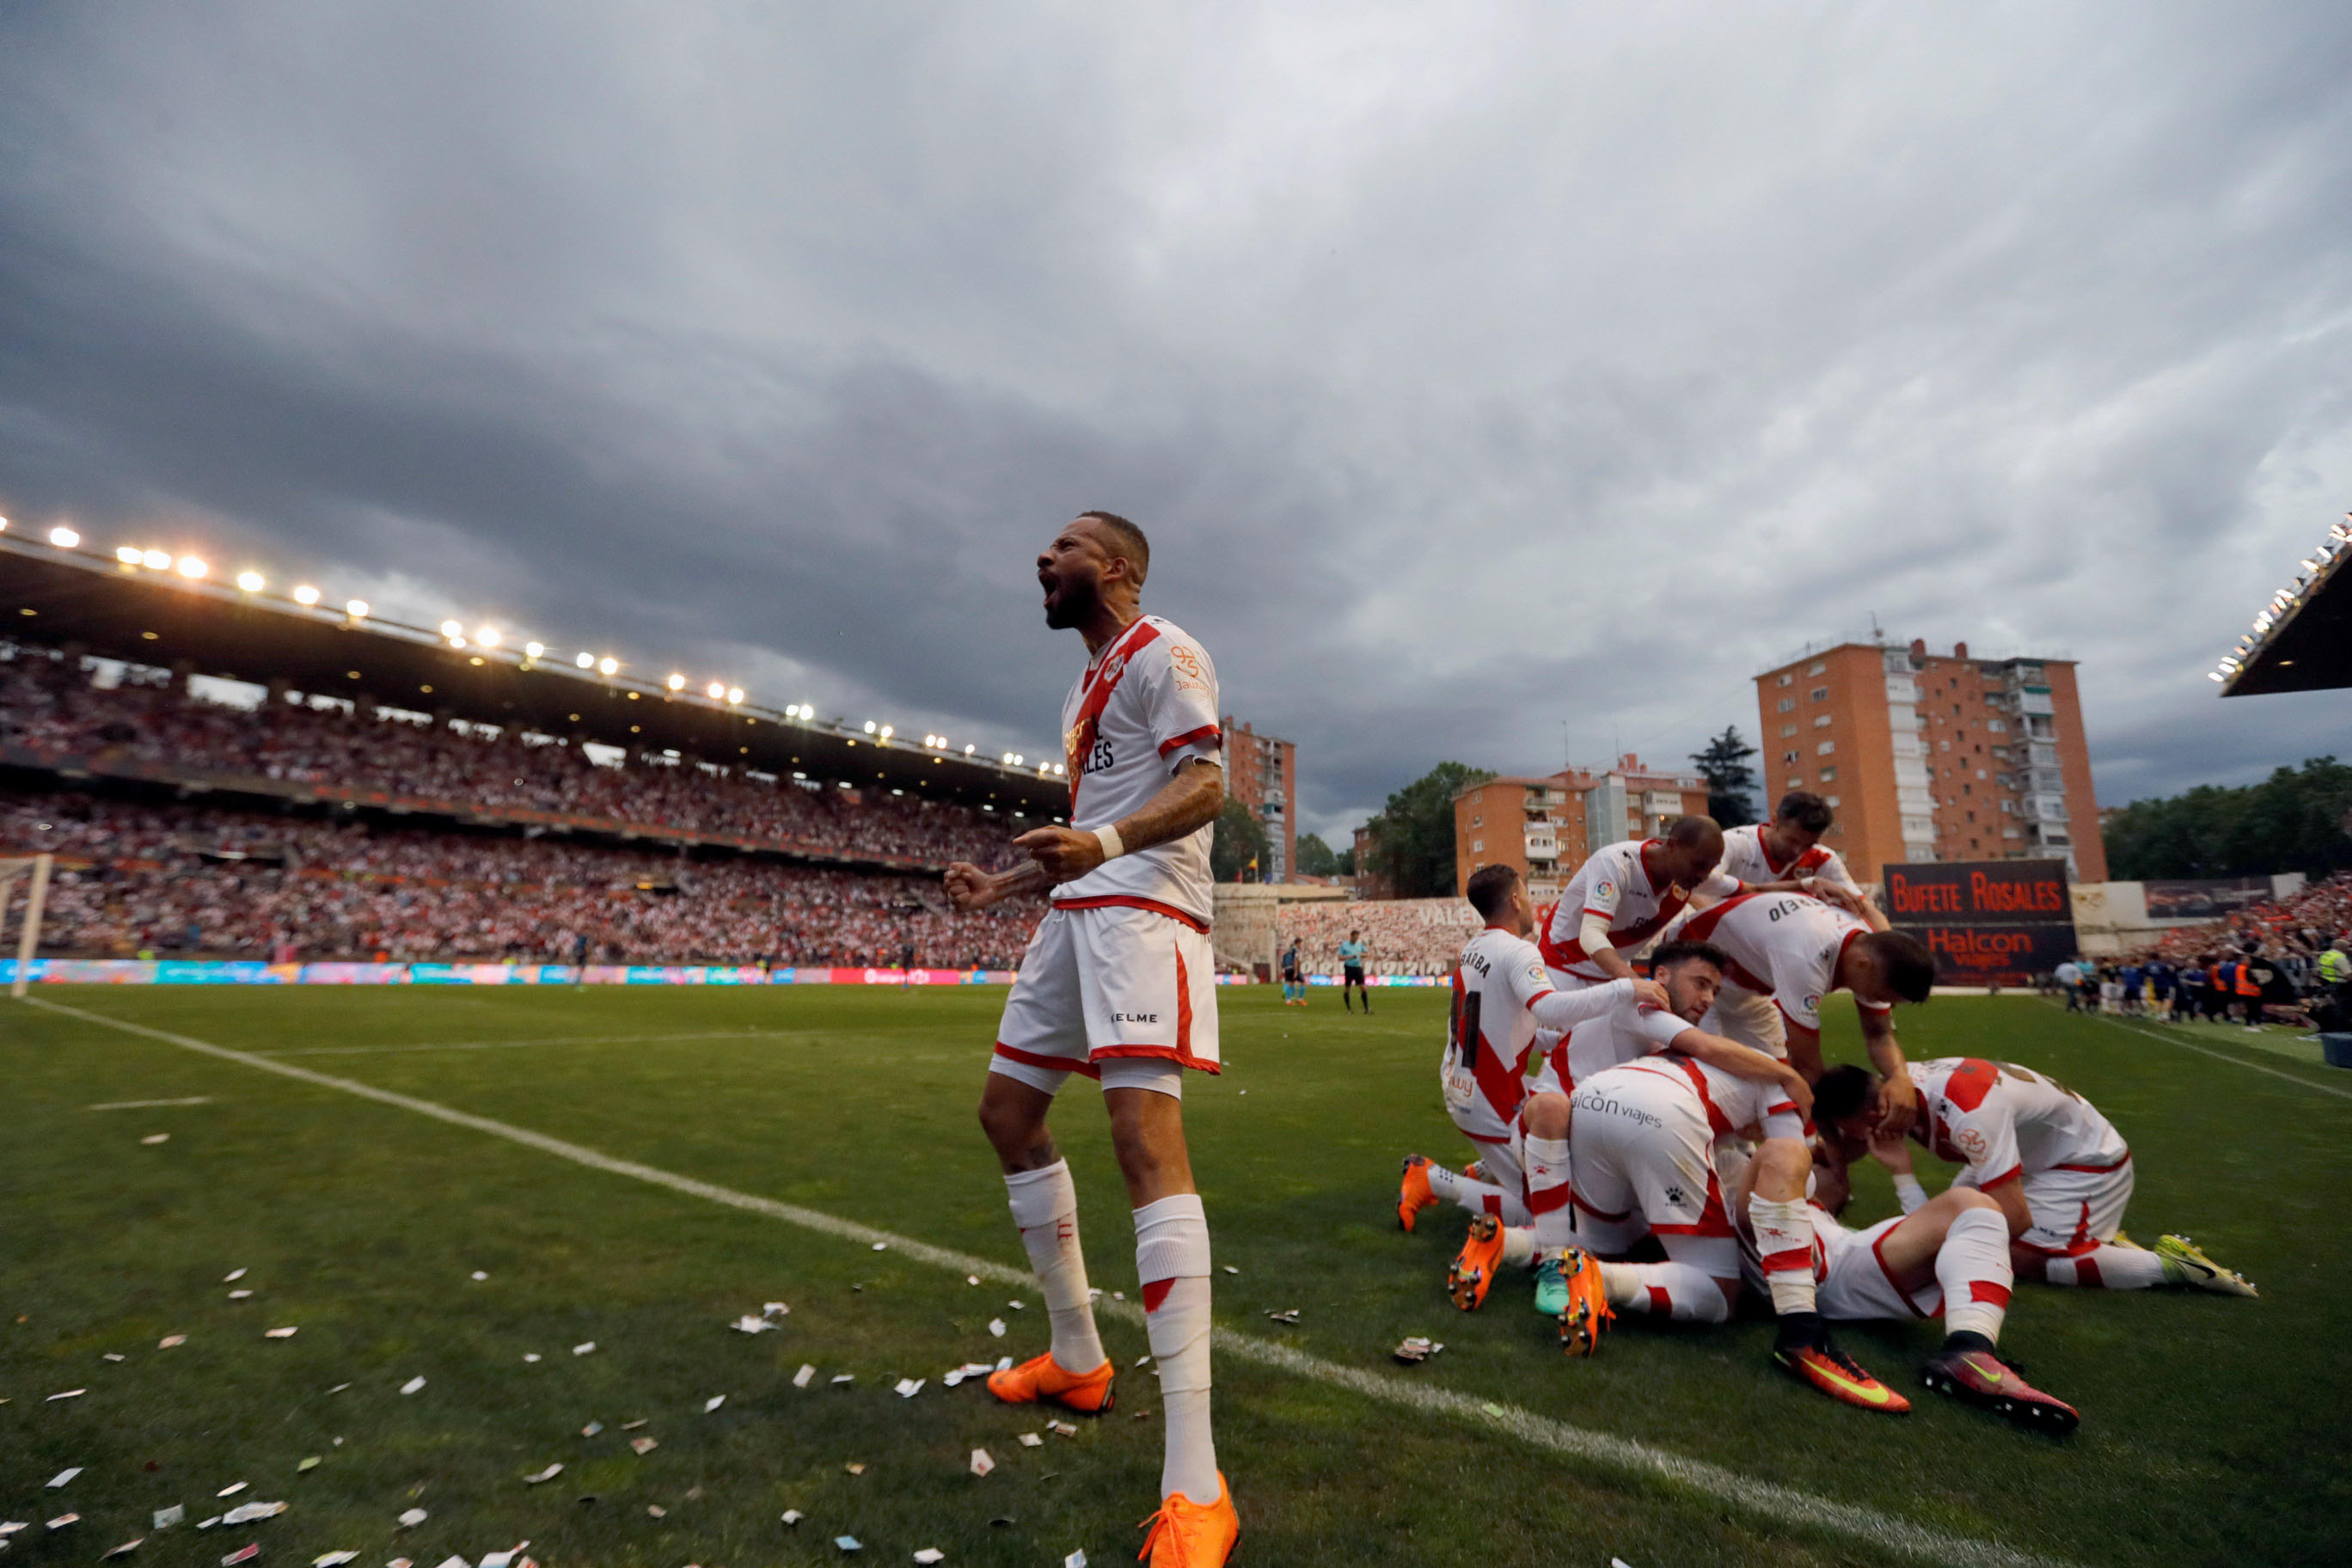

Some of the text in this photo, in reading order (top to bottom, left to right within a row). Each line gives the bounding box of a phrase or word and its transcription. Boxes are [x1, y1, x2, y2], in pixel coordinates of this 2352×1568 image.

[1892, 871, 2062, 912] BUFETE ROSALES
[1927, 928, 2033, 952] Halcon
[1622, 1106, 1663, 1129] viajes
